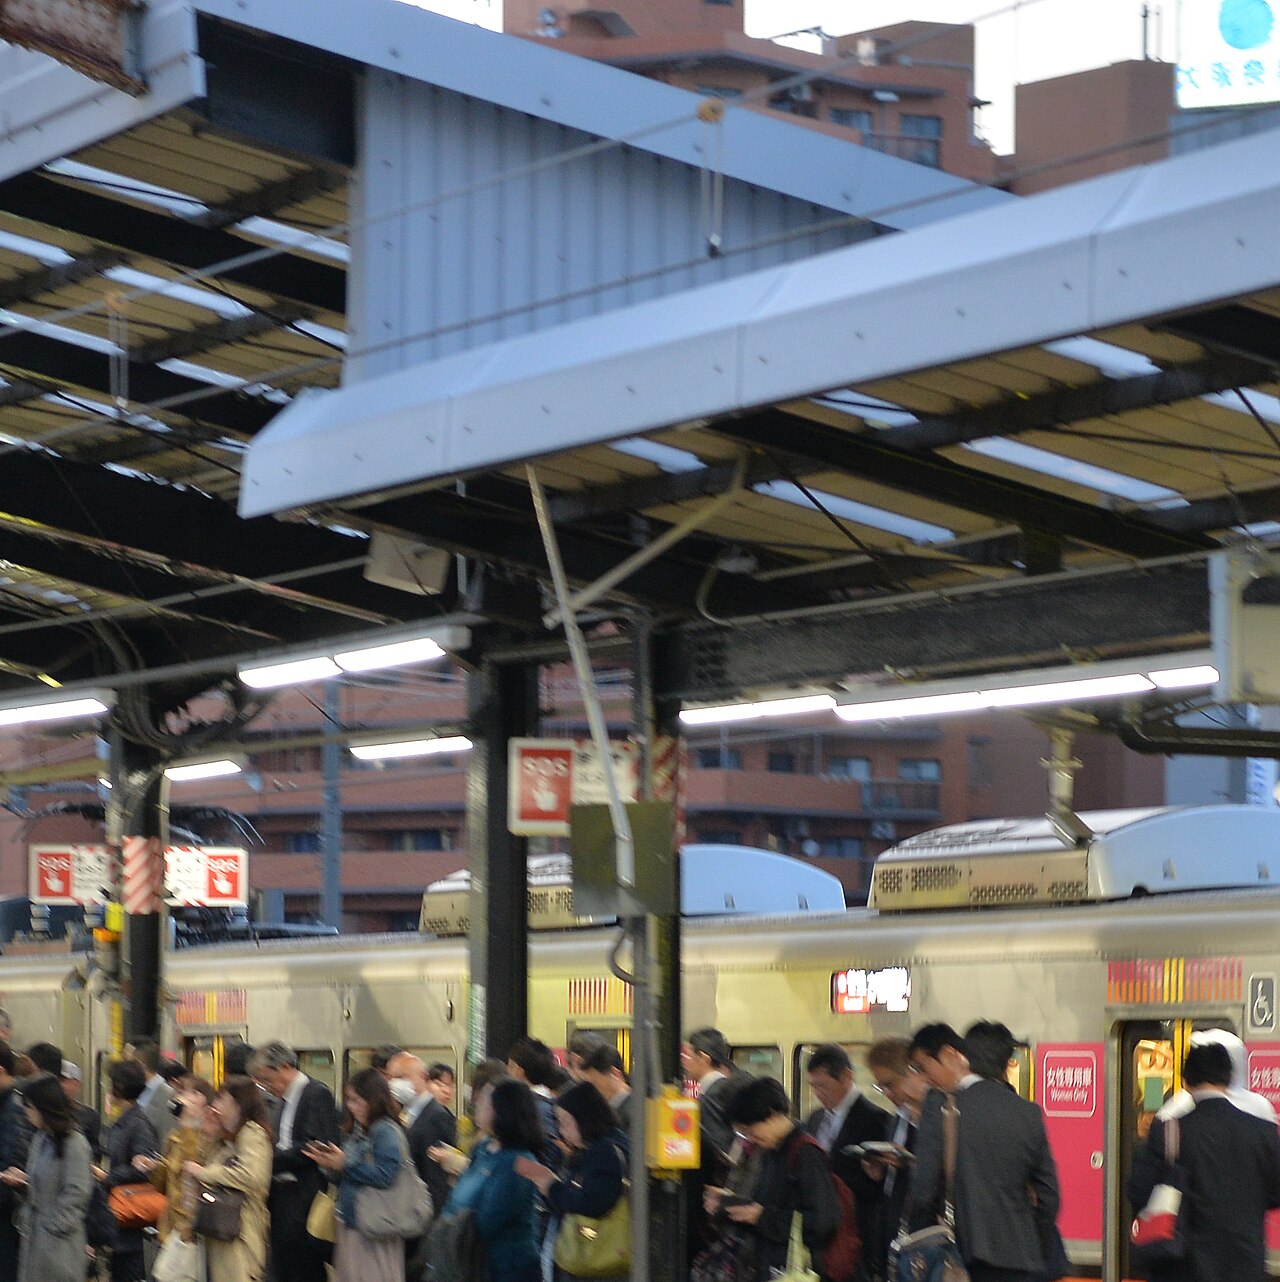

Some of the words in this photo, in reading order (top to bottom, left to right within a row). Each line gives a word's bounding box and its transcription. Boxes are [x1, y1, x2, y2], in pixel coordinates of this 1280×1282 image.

[523, 756, 569, 777] SOS
[38, 855, 71, 872] SOS
[207, 857, 240, 874] SOS
[1051, 1087, 1073, 1102] Women
[1074, 1087, 1088, 1105] Only
